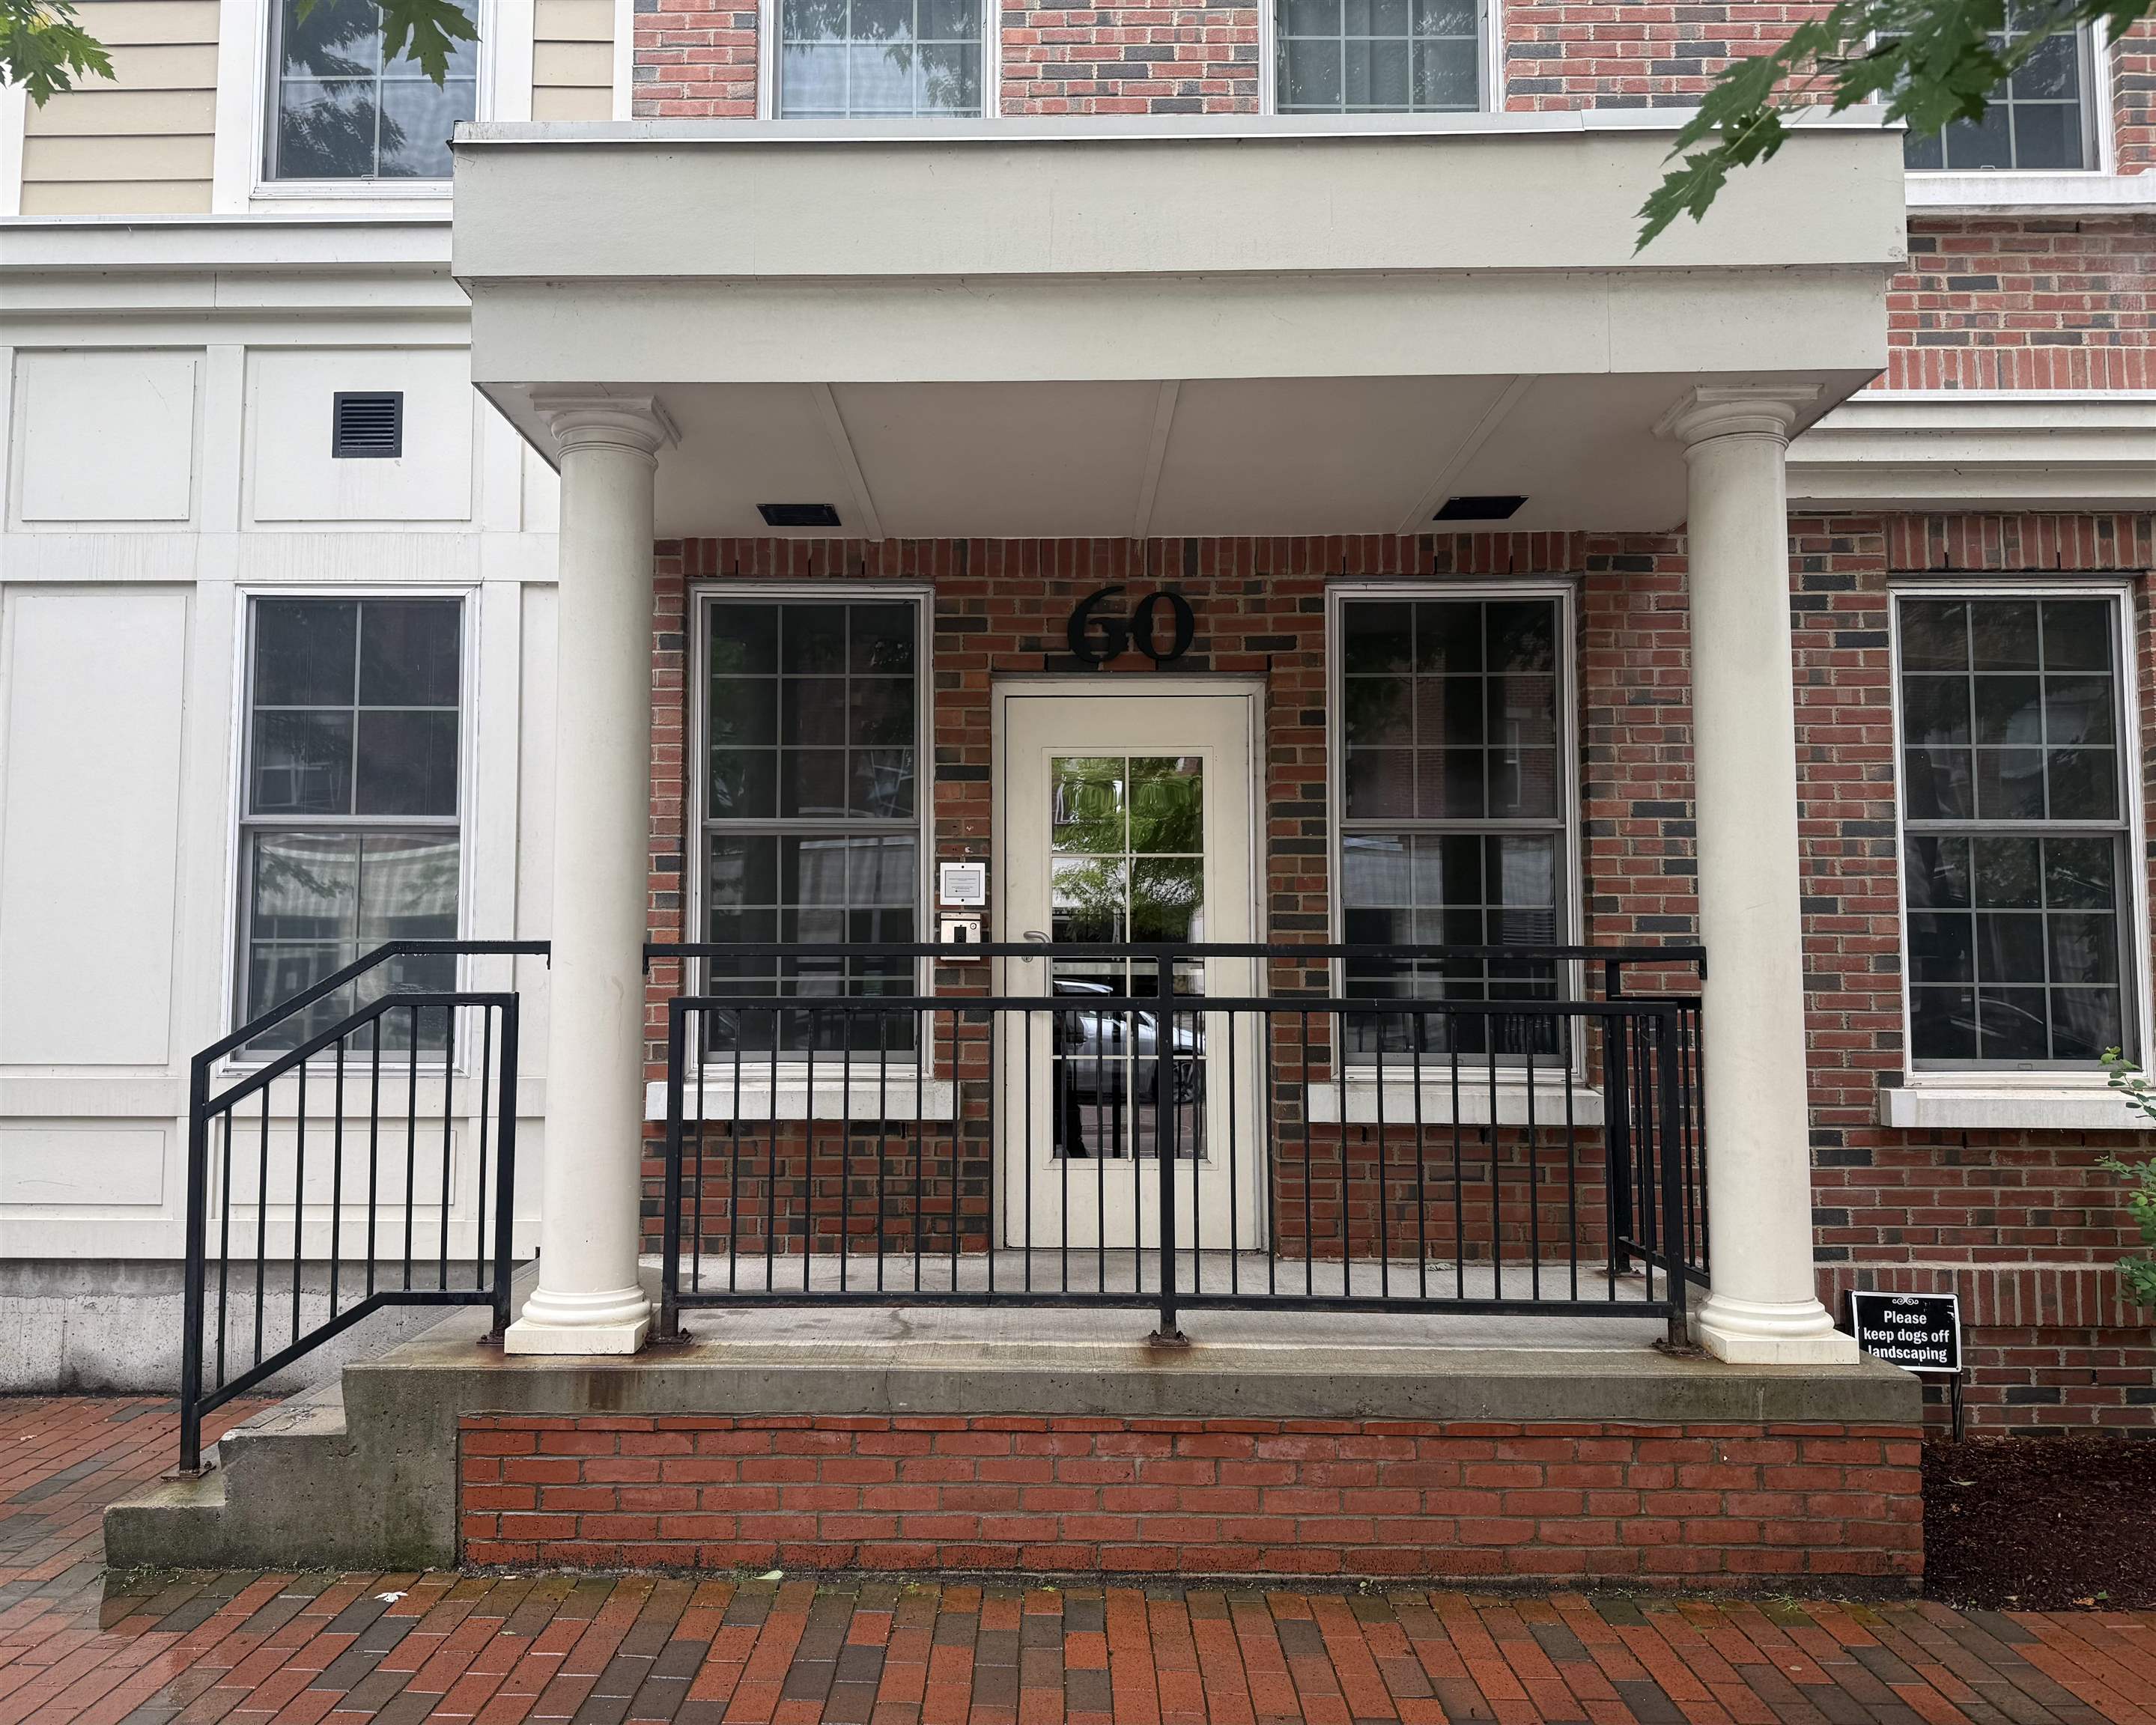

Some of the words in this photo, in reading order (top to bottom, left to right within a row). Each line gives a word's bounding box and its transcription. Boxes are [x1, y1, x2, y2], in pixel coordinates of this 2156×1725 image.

[1067, 585, 1194, 663] 60
[1883, 1310, 1927, 1324] Please
[1863, 1327, 1895, 1343] keep
[1897, 1328, 1928, 1344] dogs
[1931, 1329, 1950, 1342] off
[1868, 1345, 1948, 1363] landscaping
